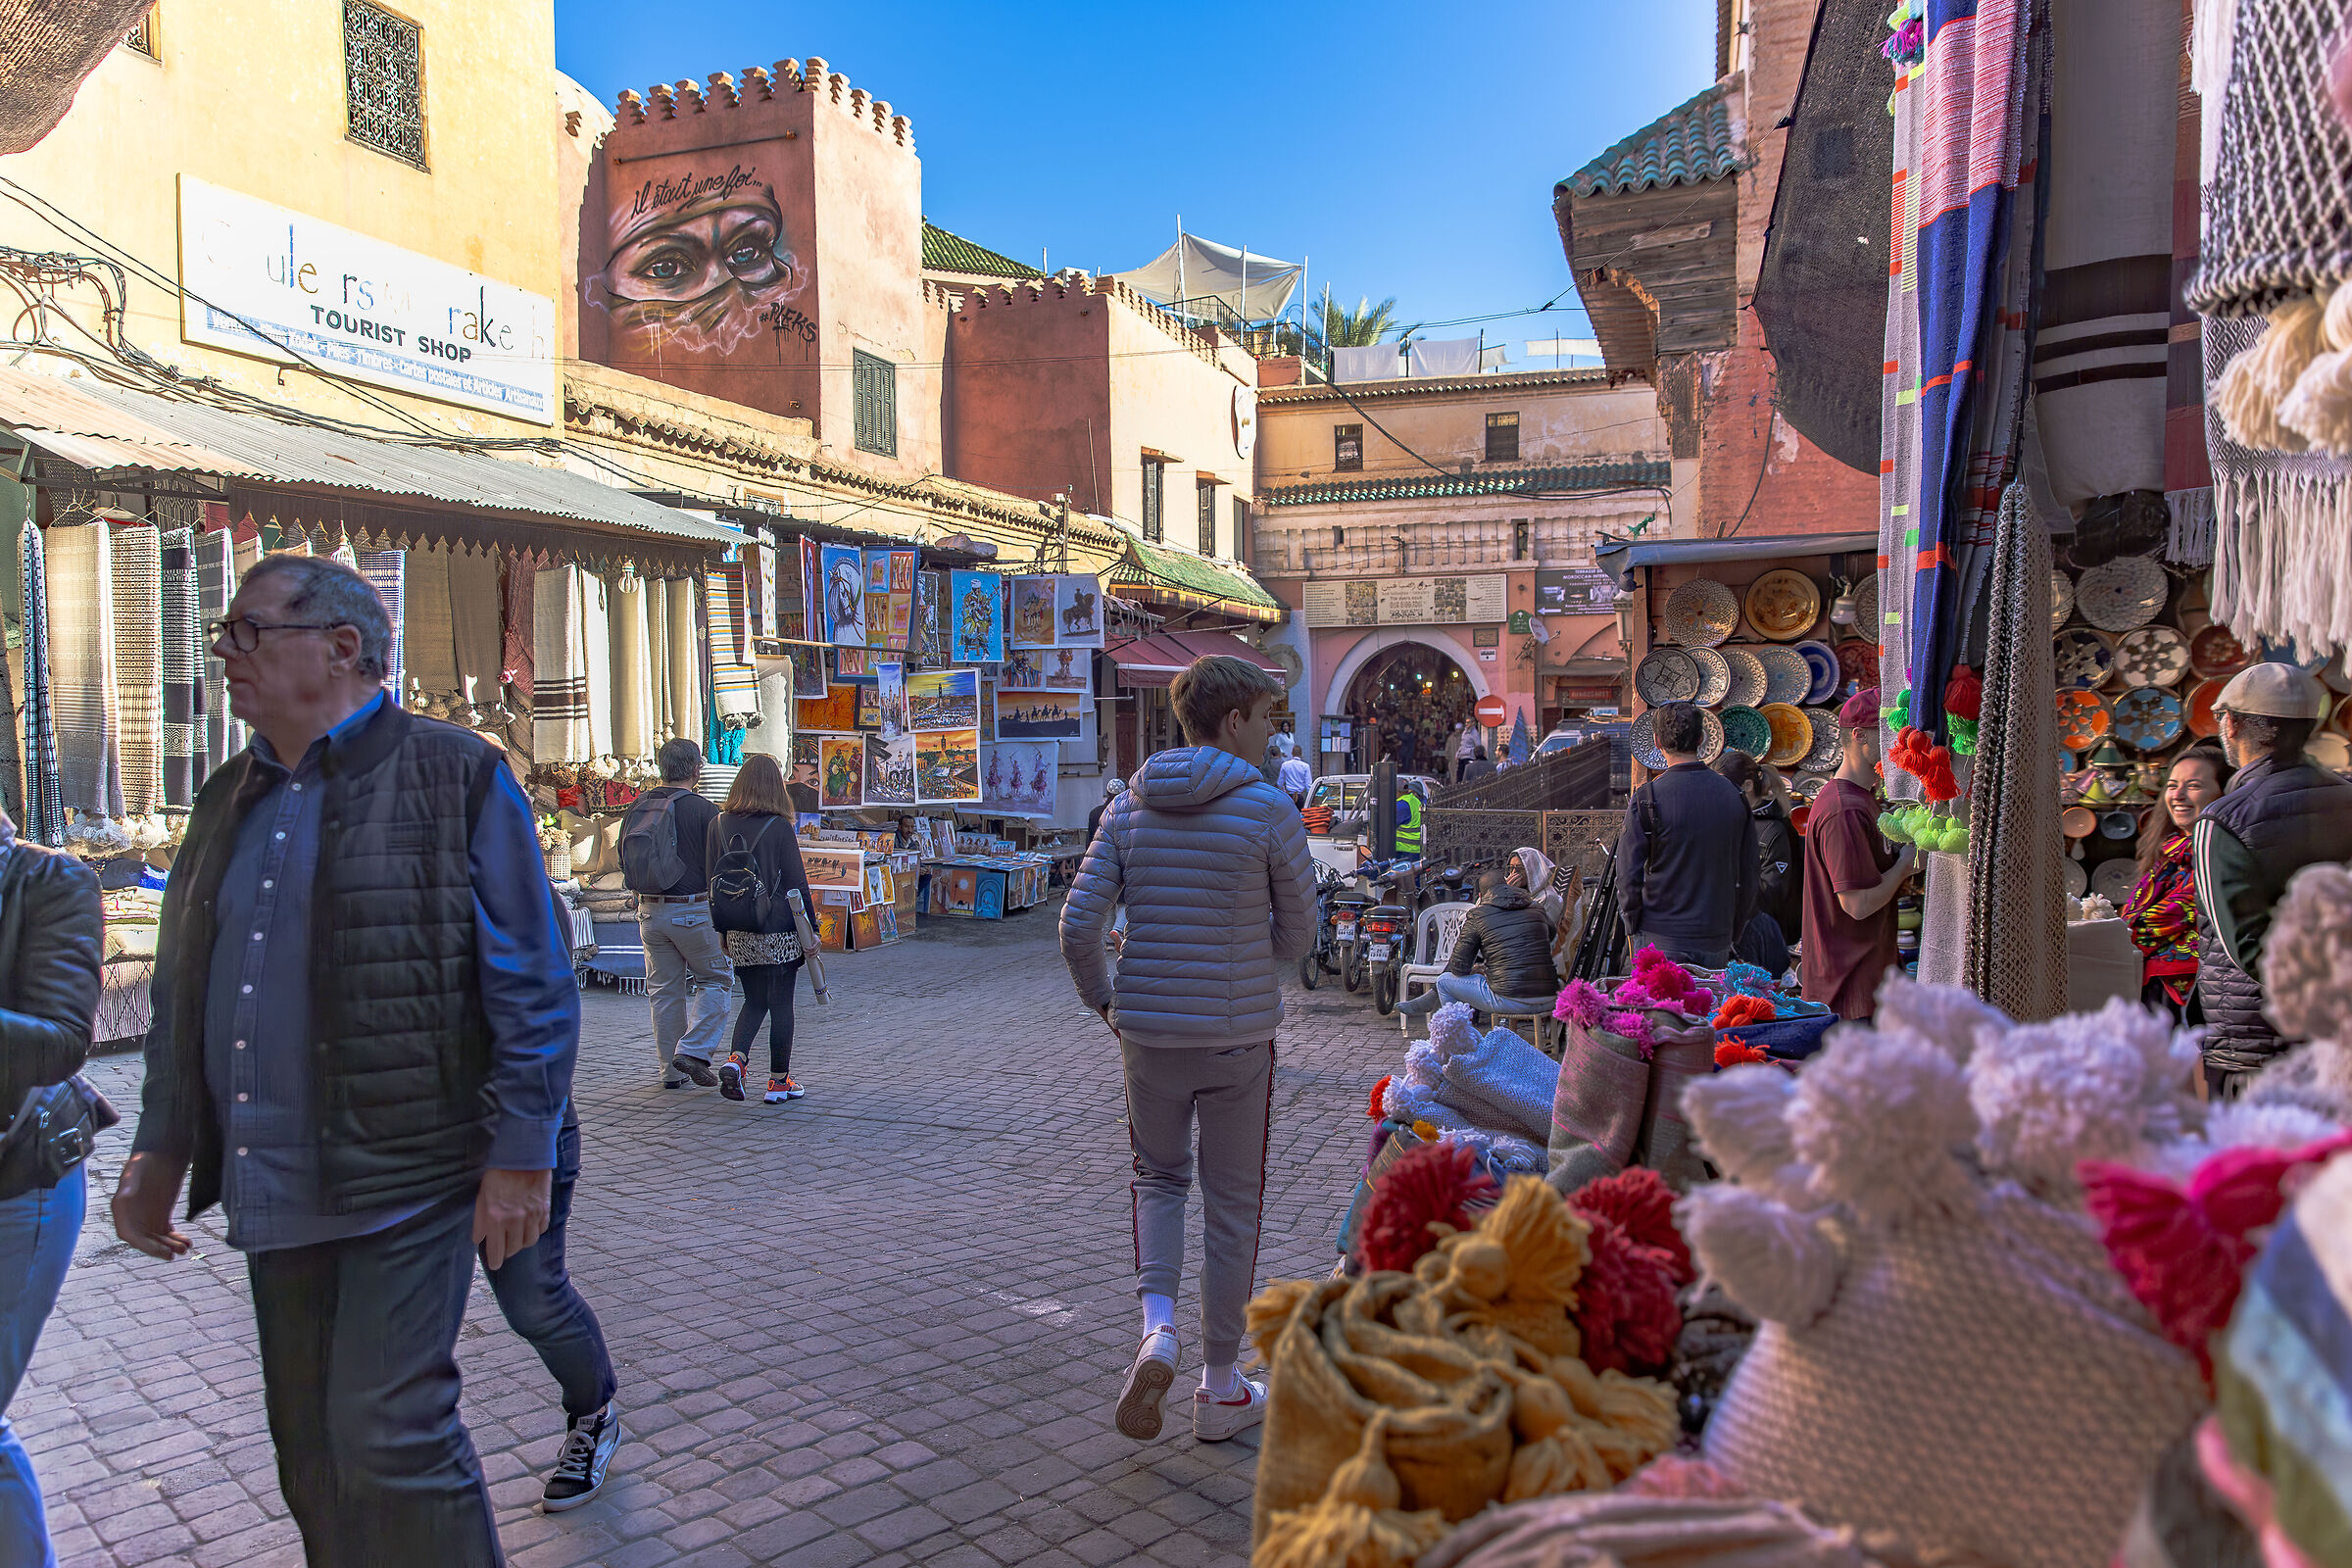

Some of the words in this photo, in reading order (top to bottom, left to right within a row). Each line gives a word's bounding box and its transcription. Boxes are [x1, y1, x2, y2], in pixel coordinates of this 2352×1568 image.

[311, 305, 406, 347] TOURIST
[418, 336, 471, 364] SHOP
[1160, 1324, 1176, 1337] NIKE
